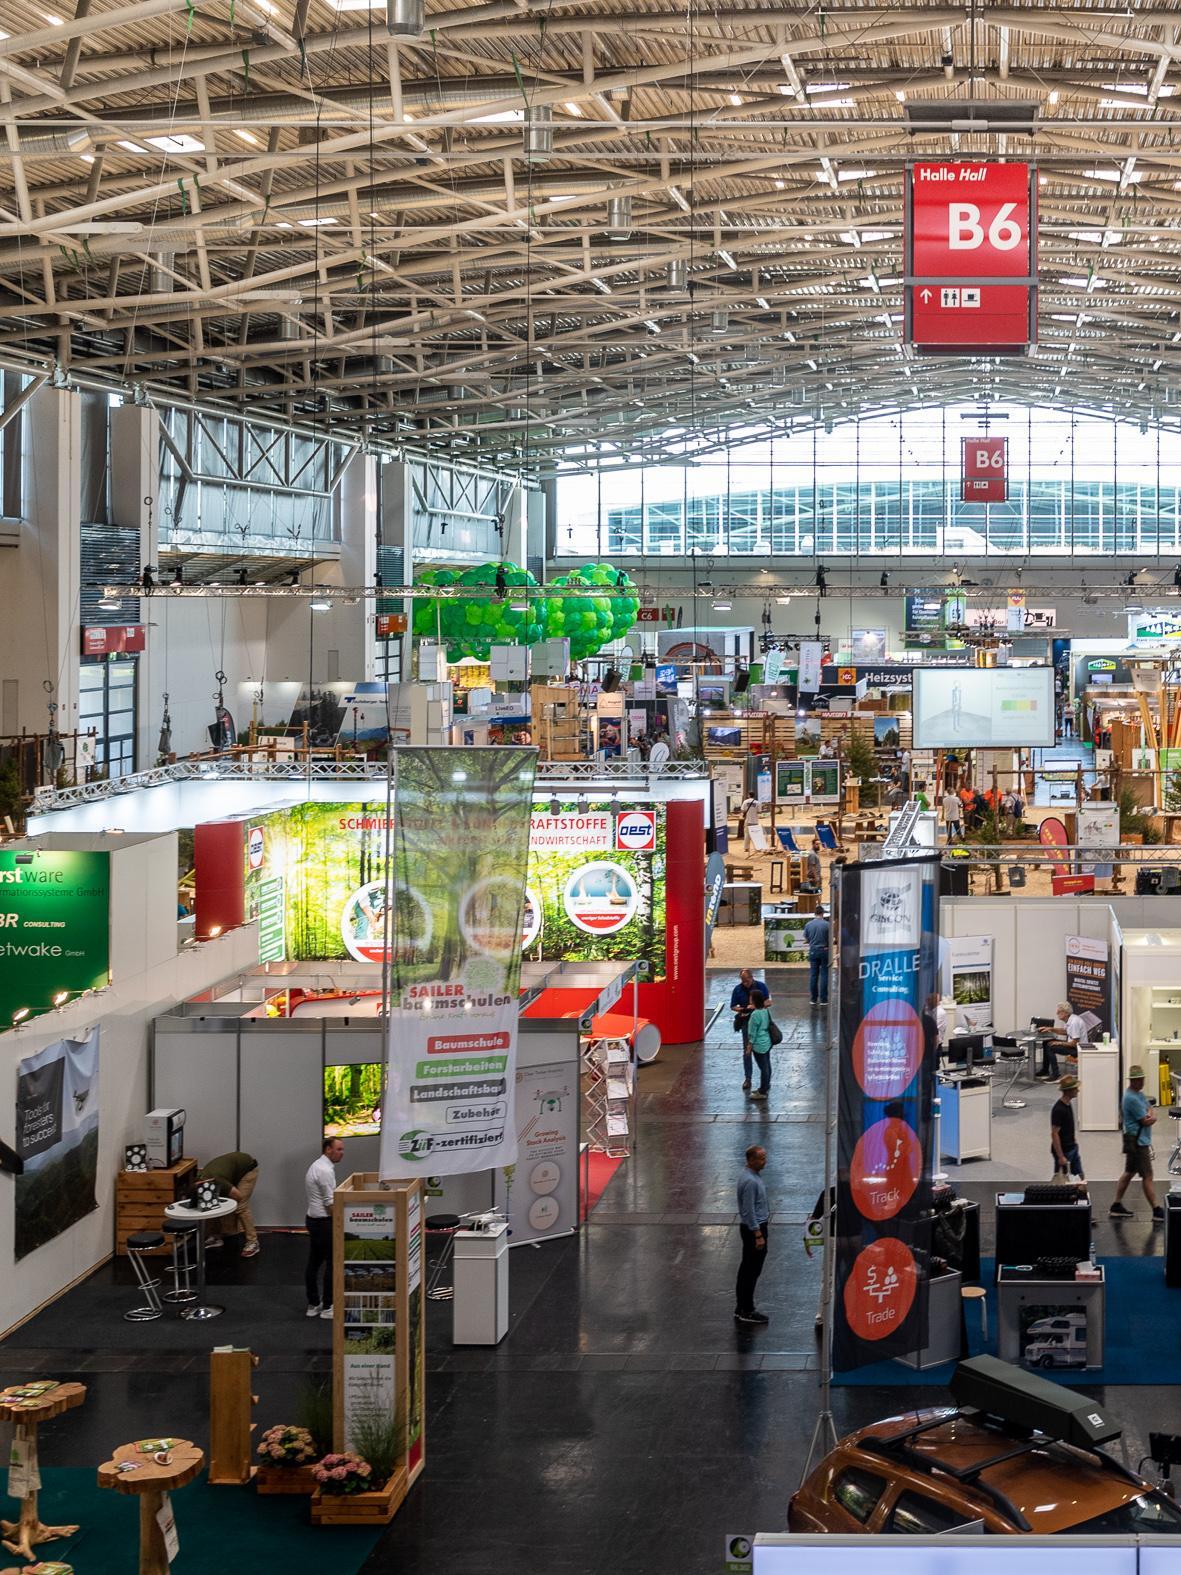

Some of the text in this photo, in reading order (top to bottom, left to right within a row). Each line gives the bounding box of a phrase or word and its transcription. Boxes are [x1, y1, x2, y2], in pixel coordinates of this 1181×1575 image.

[919, 167, 988, 182] Halle Hall
[948, 202, 1022, 250] B6
[976, 450, 1004, 468] B6
[640, 612, 652, 620] C6
[619, 824, 652, 836] oest
[858, 954, 921, 979] DRALLE
[409, 984, 465, 998] SAILER
[402, 993, 511, 1011] bamschulen
[434, 1037, 504, 1050] Baumschule
[423, 1060, 503, 1075] Forstarbeiten
[452, 1106, 502, 1120] Zubehör
[870, 1188, 900, 1204] Track
[866, 1308, 896, 1324] Trade
